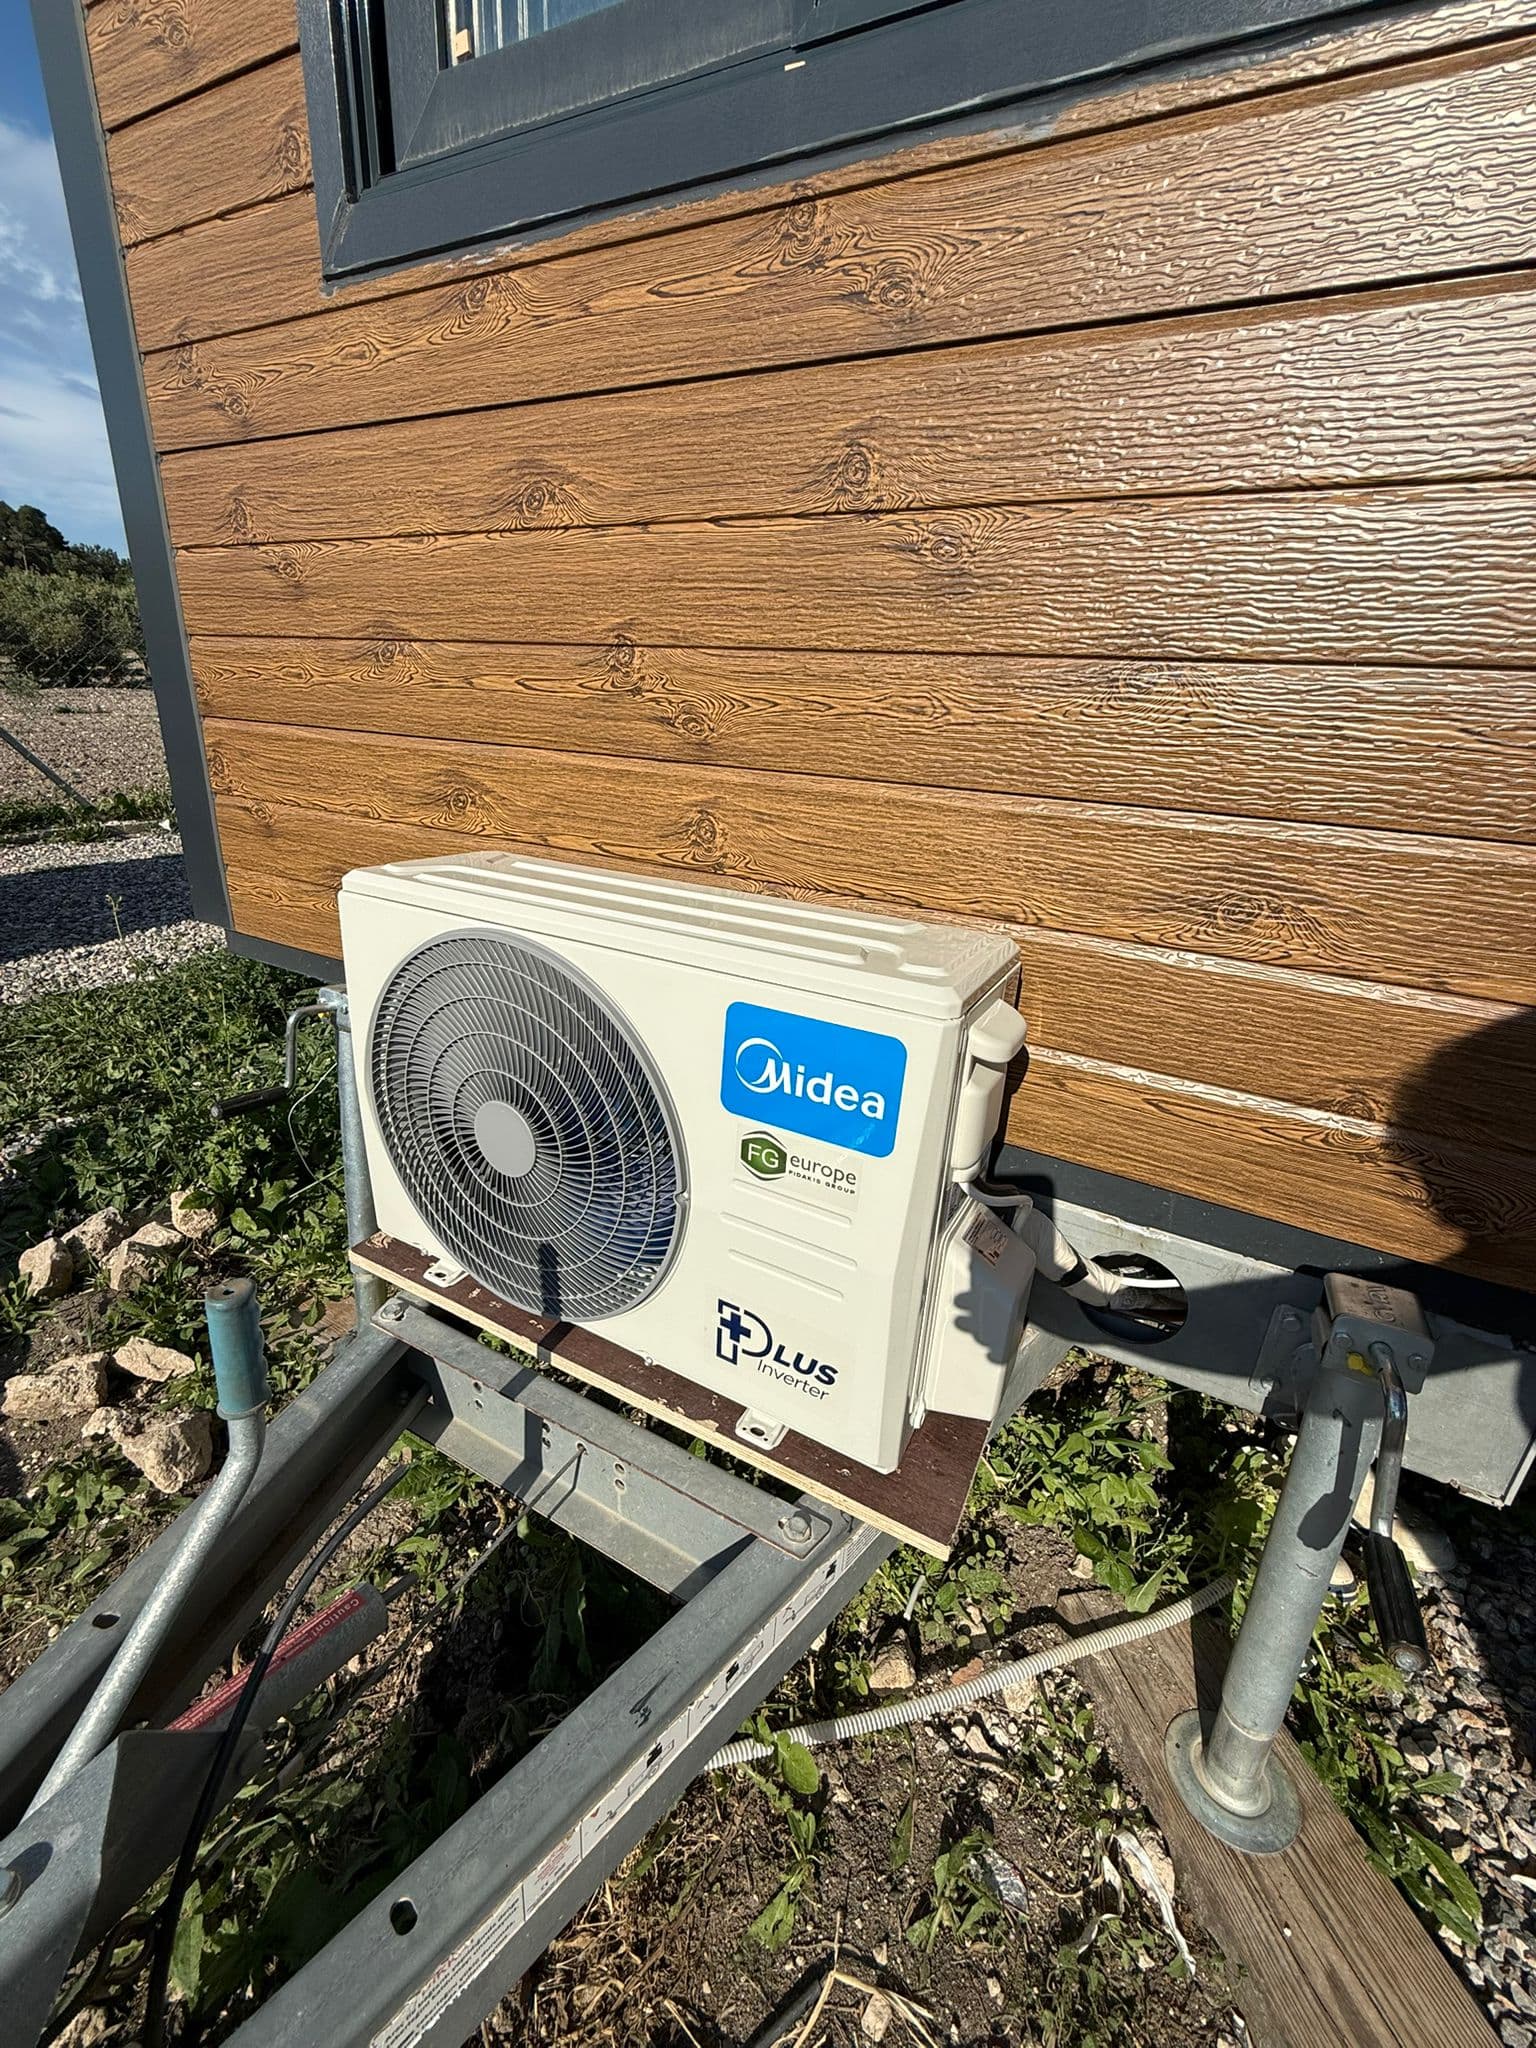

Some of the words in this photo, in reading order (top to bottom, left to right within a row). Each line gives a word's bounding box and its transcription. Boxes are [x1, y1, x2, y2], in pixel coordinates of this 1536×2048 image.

[735, 1037, 886, 1120] Midea
[747, 1143, 779, 1169] FG
[790, 1155, 857, 1185] europe
[824, 1181, 856, 1195] GROUP
[757, 1359, 830, 1400] Inverter
[311, 1598, 360, 1638] Caution!
